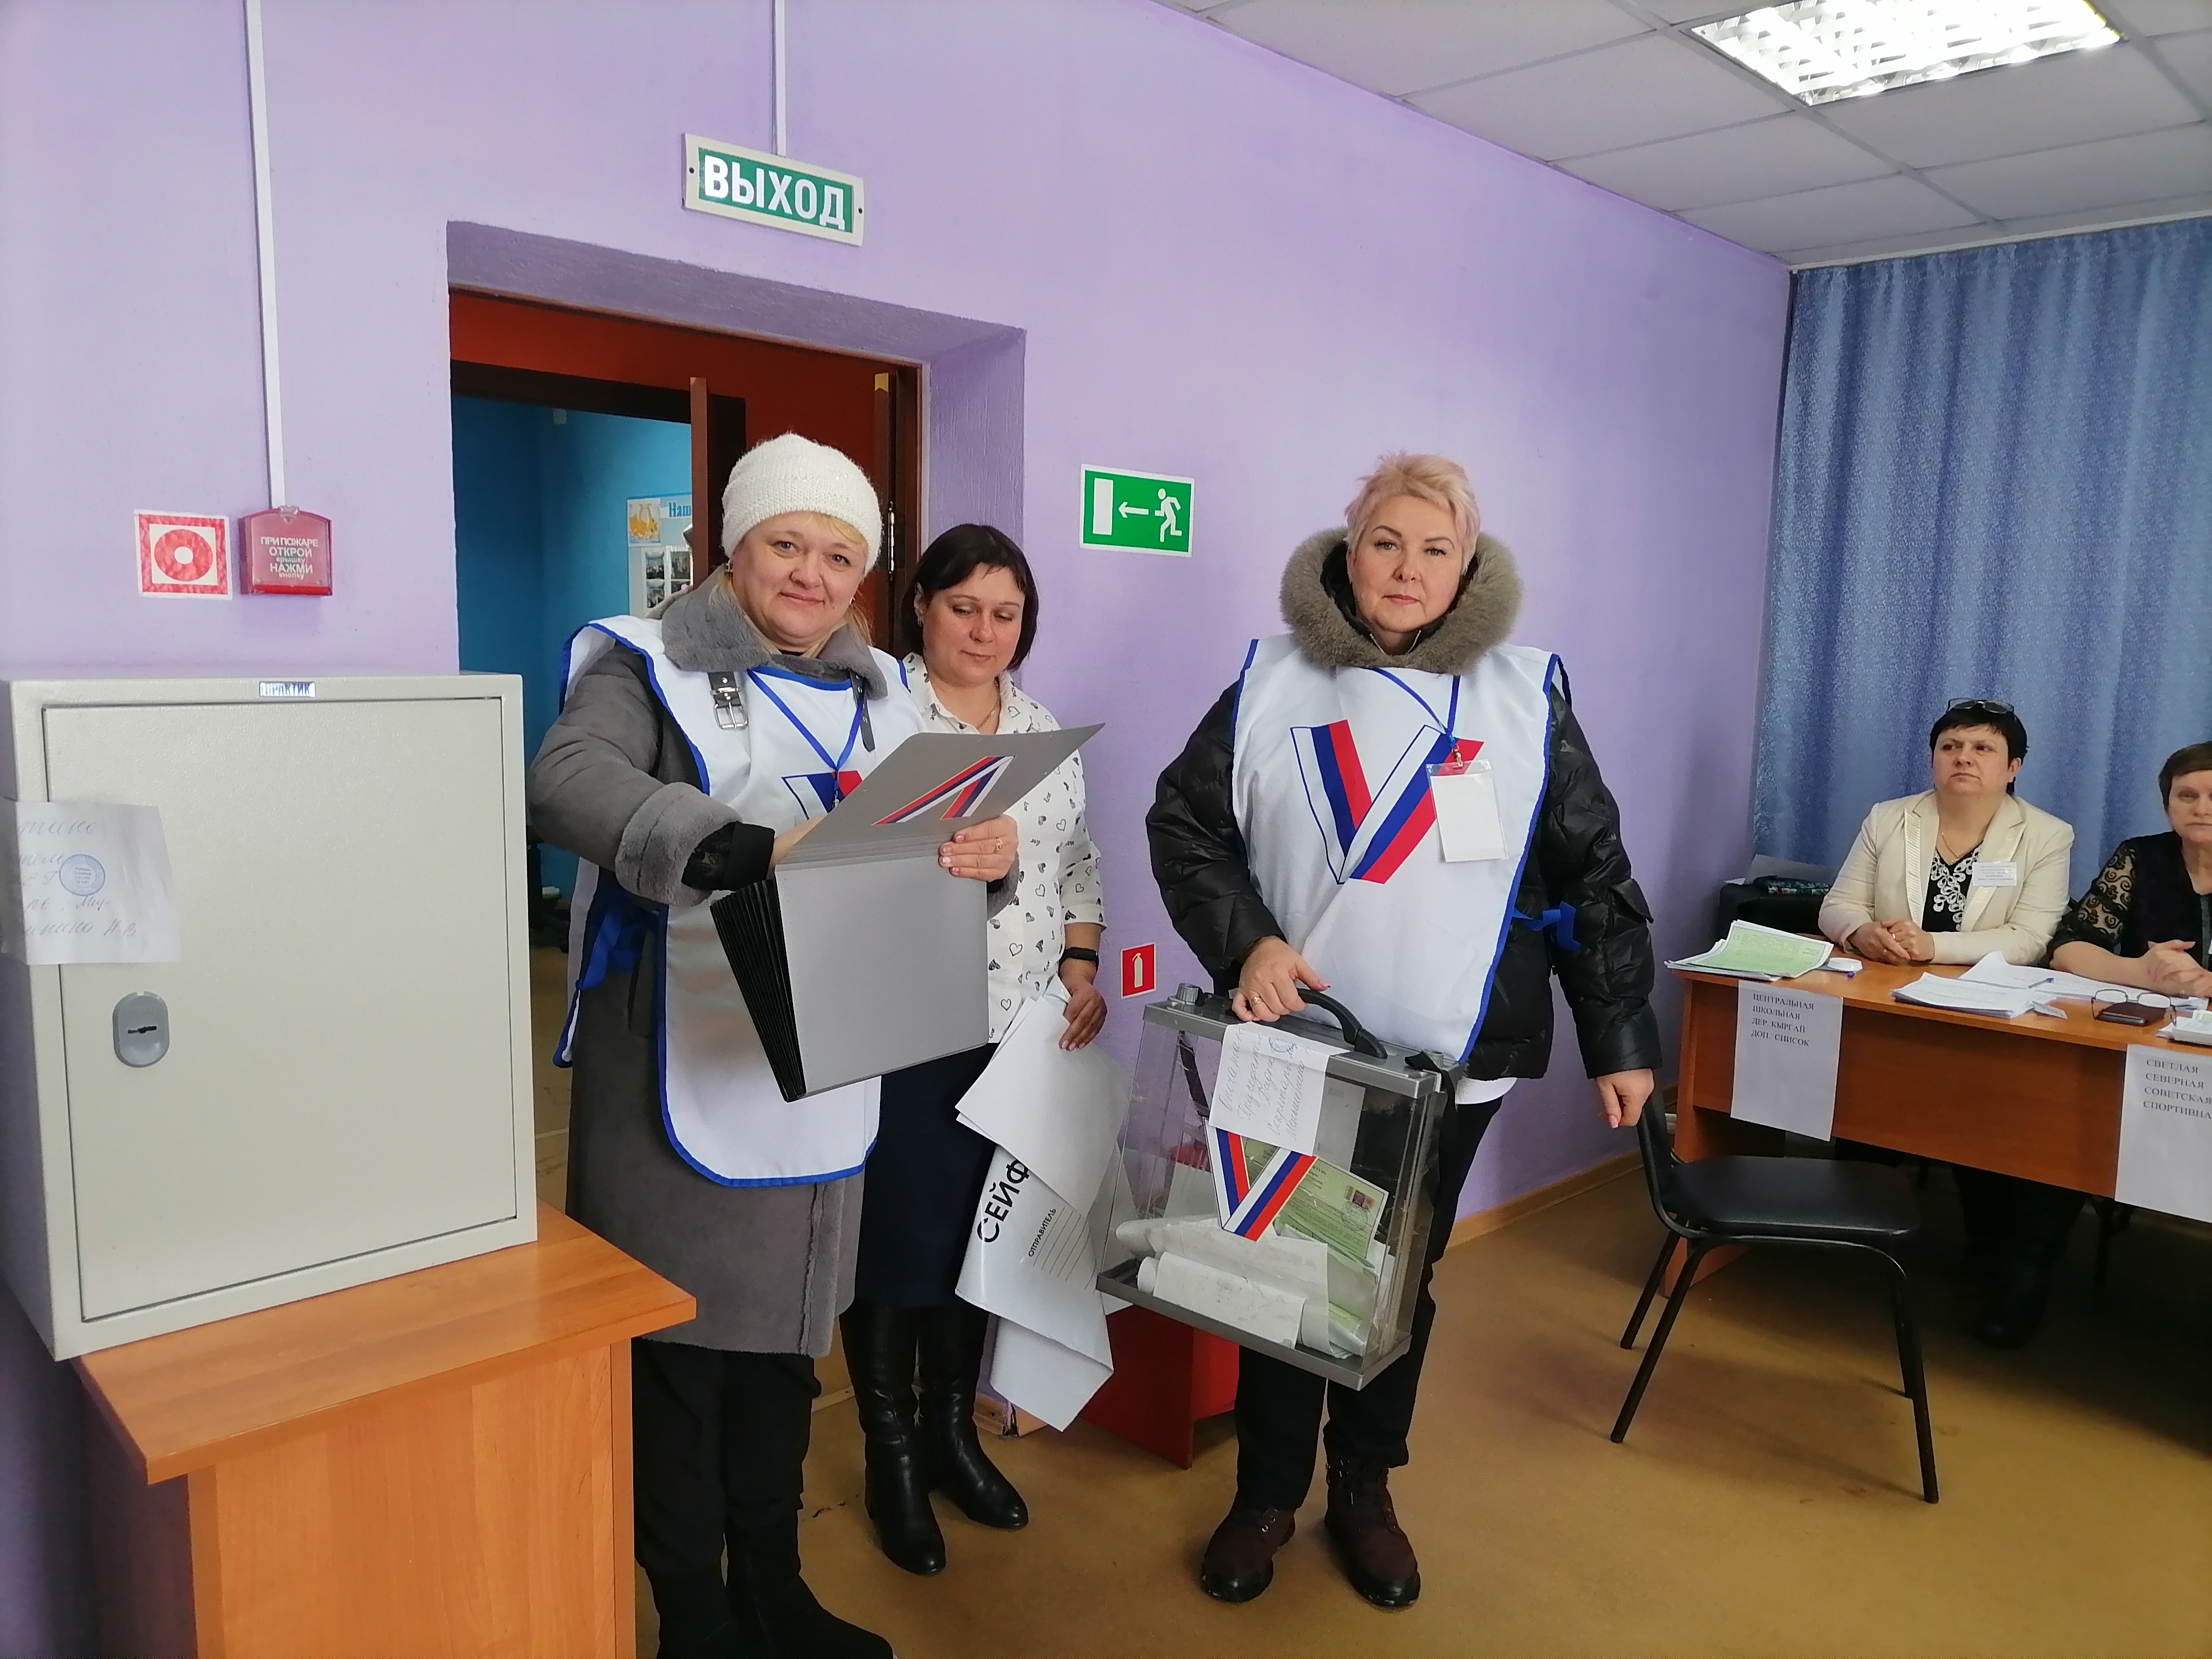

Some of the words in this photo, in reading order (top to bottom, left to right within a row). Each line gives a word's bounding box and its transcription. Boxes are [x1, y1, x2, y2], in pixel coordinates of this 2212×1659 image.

[704, 154, 845, 230] ВЫХОД
[261, 536, 280, 545] ПРИ
[280, 537, 319, 547] ПОЖАРЕ
[270, 563, 313, 574] НАЖМИ
[1753, 993, 1814, 1010] ЦЕНТРАЛЬНАЯ
[1752, 1005, 1800, 1020] ШКОЛЬНАЯ
[1775, 1034, 1810, 1047] СПИСОК
[2146, 1059, 2198, 1074] СВЕТЛАЯ
[2146, 1073, 2204, 1089] СЕВЕРНАЯ
[2144, 1087, 2212, 1105] СОВЕТСКАЯ
[977, 1159, 1030, 1243] СЕЙФ
[1028, 1208, 1056, 1257] ОТПРАВИТЕЛЬ
